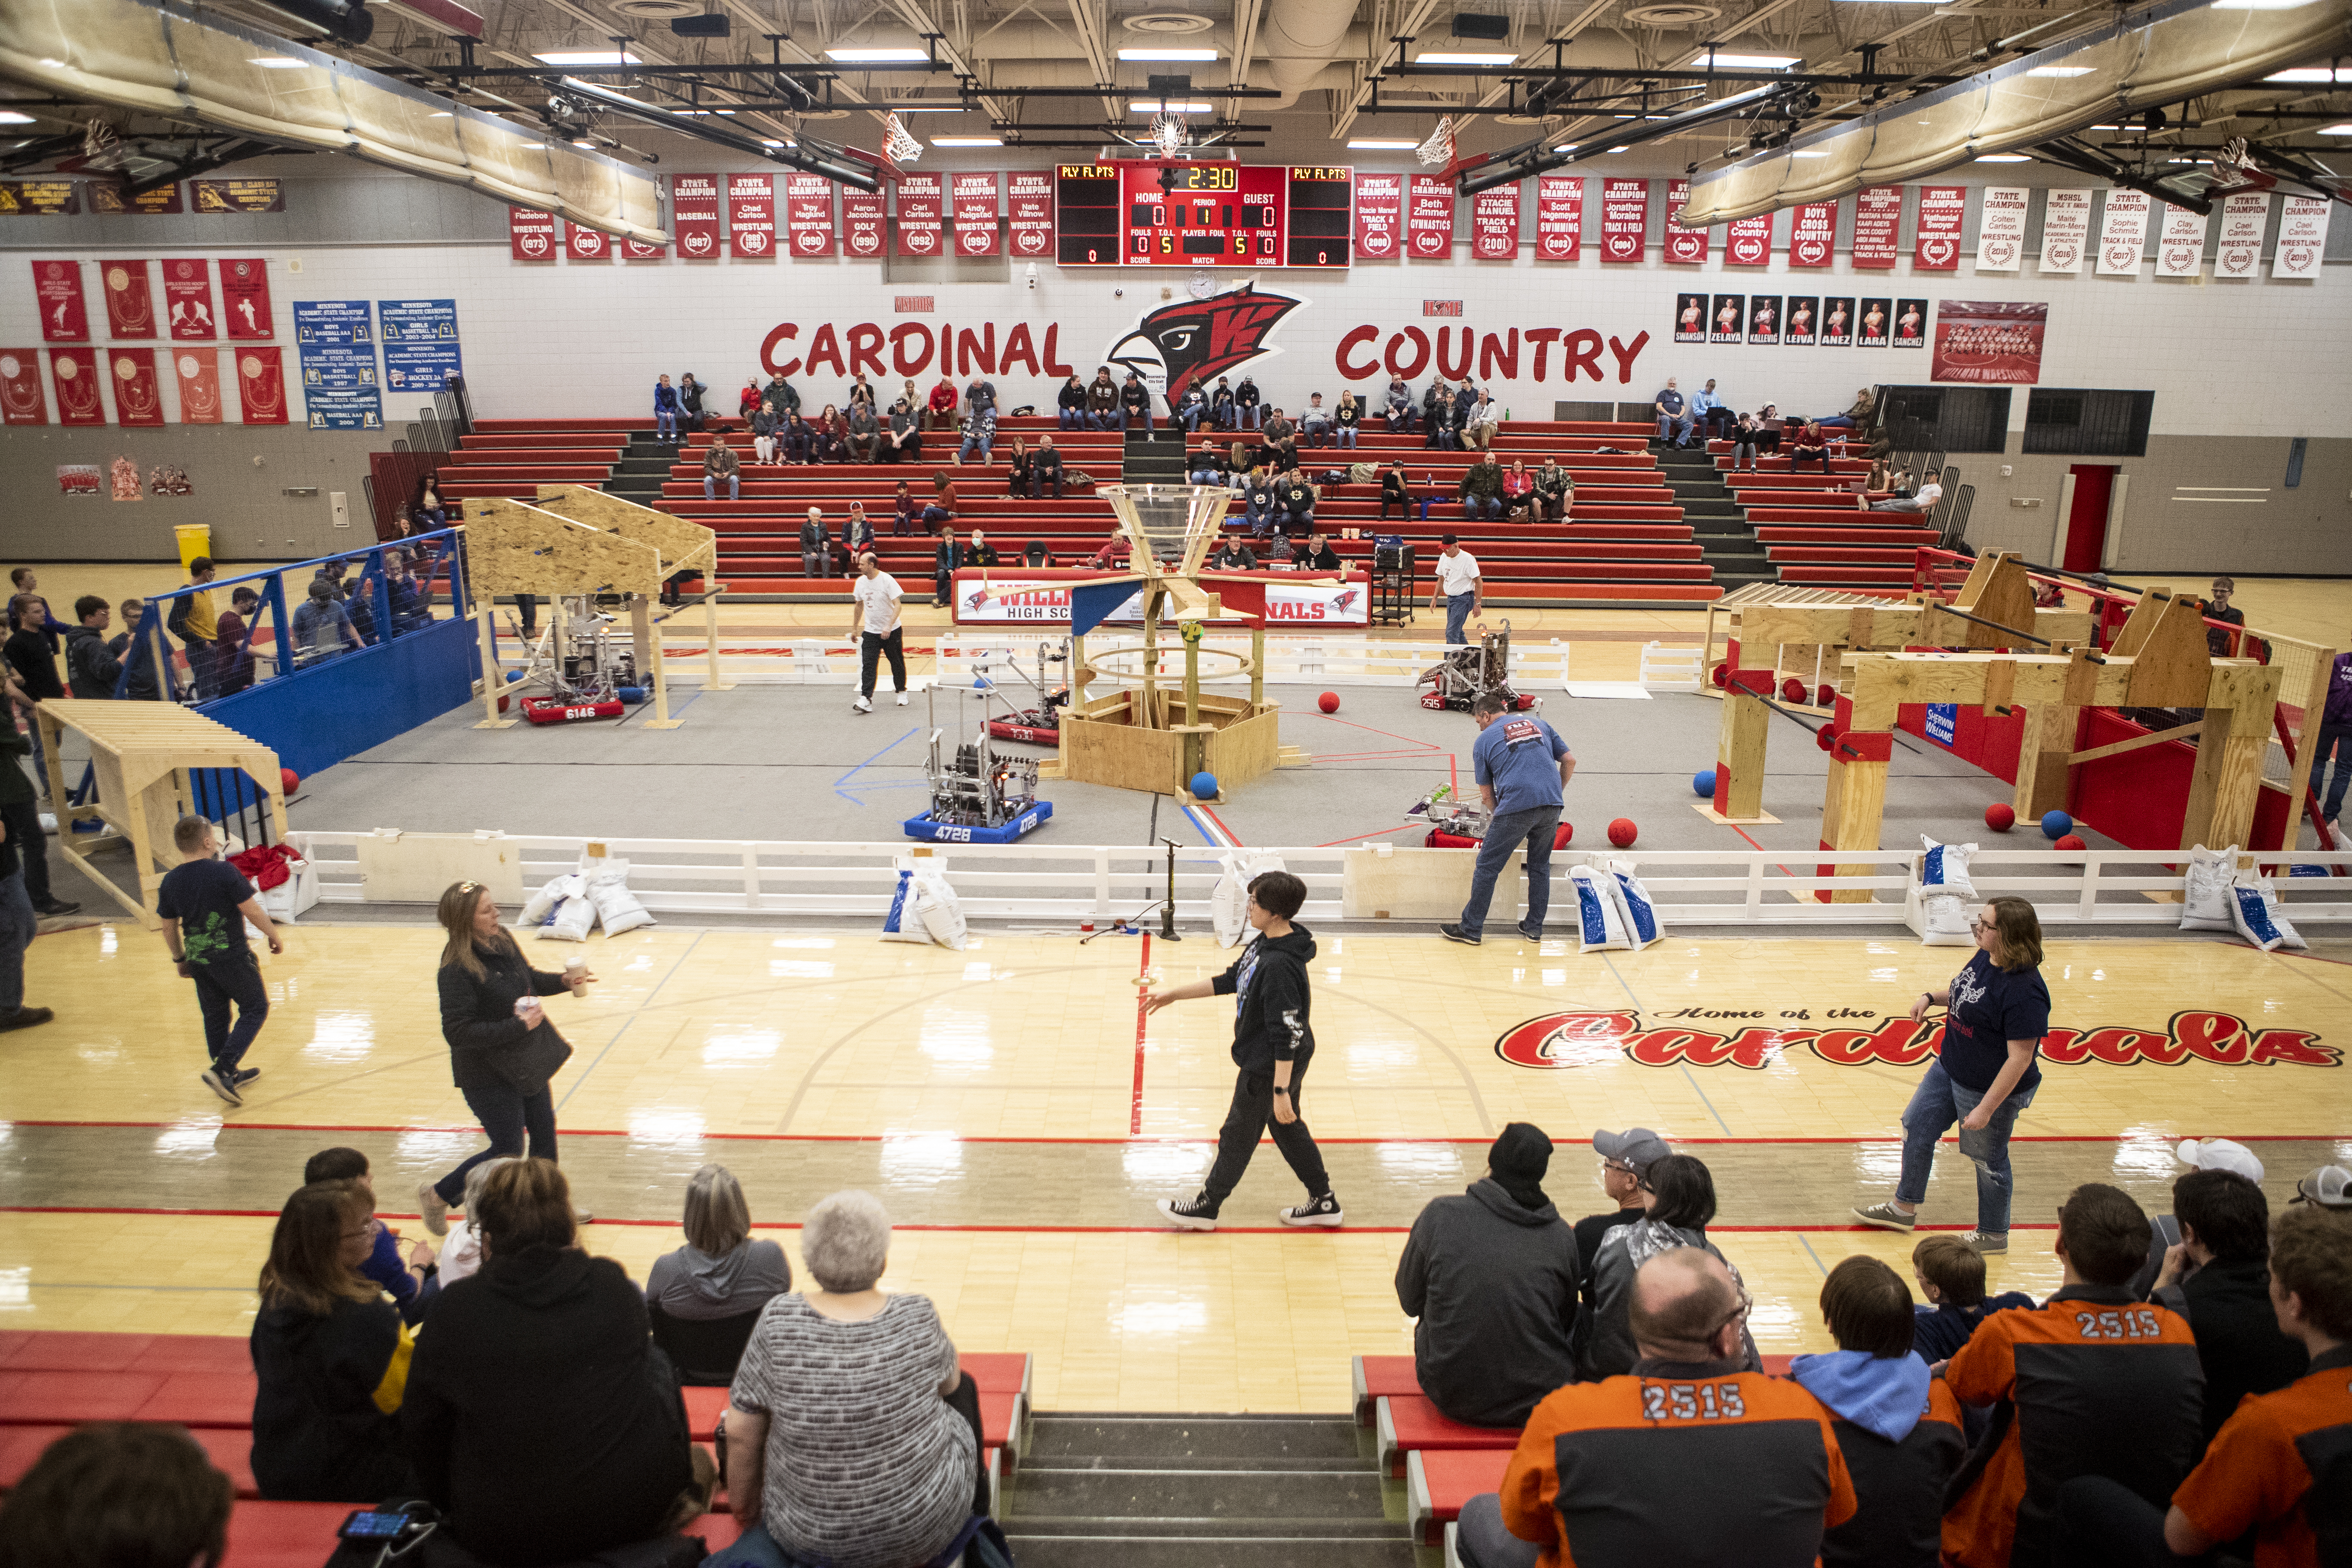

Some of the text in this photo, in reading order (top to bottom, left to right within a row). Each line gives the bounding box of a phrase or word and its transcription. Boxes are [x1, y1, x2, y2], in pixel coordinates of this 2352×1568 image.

[1062, 166, 1114, 177] PLY FL PTS
[1295, 168, 1346, 179] PLY FL PTS
[906, 178, 933, 186] STATE
[1017, 177, 1044, 186] STATE
[1188, 167, 1234, 188] 2:30
[682, 179, 708, 187] STATE
[737, 179, 763, 187] STATE
[1364, 180, 1391, 188] STATE
[1549, 181, 1575, 190] STATE
[675, 187, 716, 196] CHAMPION
[730, 187, 772, 196] CHAMPION
[898, 187, 940, 195] CHAMPION
[1010, 186, 1051, 194] CHAMPION
[1357, 187, 1400, 196] CHAMPION
[1412, 186, 1453, 195] CHAMPION
[1541, 190, 1581, 198] CHAMPION
[1930, 191, 1957, 199] STATE
[1136, 193, 1163, 203] HOME
[1244, 194, 1274, 204] GUEST
[1421, 199, 1442, 208] Beth
[1551, 202, 1570, 211] Scott
[1921, 199, 1963, 208] CHAMPION
[1985, 201, 2026, 209] CHAMPION
[1153, 205, 1165, 226] 0
[1205, 209, 1209, 223] 1
[1263, 206, 1275, 227] 0
[1413, 207, 1449, 217] Zimmer
[1540, 211, 1579, 221] Hagemeyer
[1805, 208, 1826, 218] BOYS
[1923, 214, 1958, 222] Nathanial
[900, 222, 941, 230] WRESTLING
[1411, 219, 1451, 230] GYMNASTICS
[1540, 223, 1579, 233] SWIMMING
[1801, 219, 1828, 230] CROSS
[1926, 221, 1954, 230] Swoyer
[910, 236, 930, 245] 1992
[1022, 236, 1041, 245] 1994
[1794, 230, 1832, 241] COUNTRY
[1918, 232, 1960, 240] WRESTLING
[689, 238, 708, 247] 1987
[856, 237, 875, 246] 1990
[1138, 236, 1148, 253] 0
[1162, 236, 1172, 254] 5
[1235, 237, 1245, 254] 5
[1264, 237, 1274, 254] 0
[1369, 238, 1387, 247] 2000
[1421, 238, 1438, 246] 2001
[1550, 240, 1567, 248] 2003
[1803, 247, 1821, 256] 2006
[1930, 246, 1946, 254] 2011
[1088, 249, 1096, 263] 0
[1319, 251, 1326, 264] 0
[895, 297, 934, 312] VISITORS
[1424, 300, 1462, 316] HOME
[1675, 332, 1705, 341] SWANSON
[1711, 333, 1741, 341] ZELAYA
[1749, 334, 1778, 343] KALLEVIG
[1785, 334, 1814, 344] LEIVA
[1822, 335, 1850, 345] ANEZ
[1859, 336, 1887, 346] LARA
[1894, 337, 1923, 346] SANCHEZ
[760, 322, 1074, 378] CARDINAL
[1335, 325, 1650, 383] COUNTRY
[1008, 608, 1072, 618] HIGH SC
[1422, 698, 1440, 709] 2515
[567, 707, 596, 719] 6146
[1927, 709, 1954, 730] SHERWIN
[1926, 720, 1953, 743] WILLIAMS
[1019, 812, 1037, 834] 4728
[935, 826, 971, 842] 4728
[1653, 1008, 1877, 1020] Home of the
[2076, 1310, 2160, 1338] 2515
[1644, 1384, 1746, 1419] 2515
